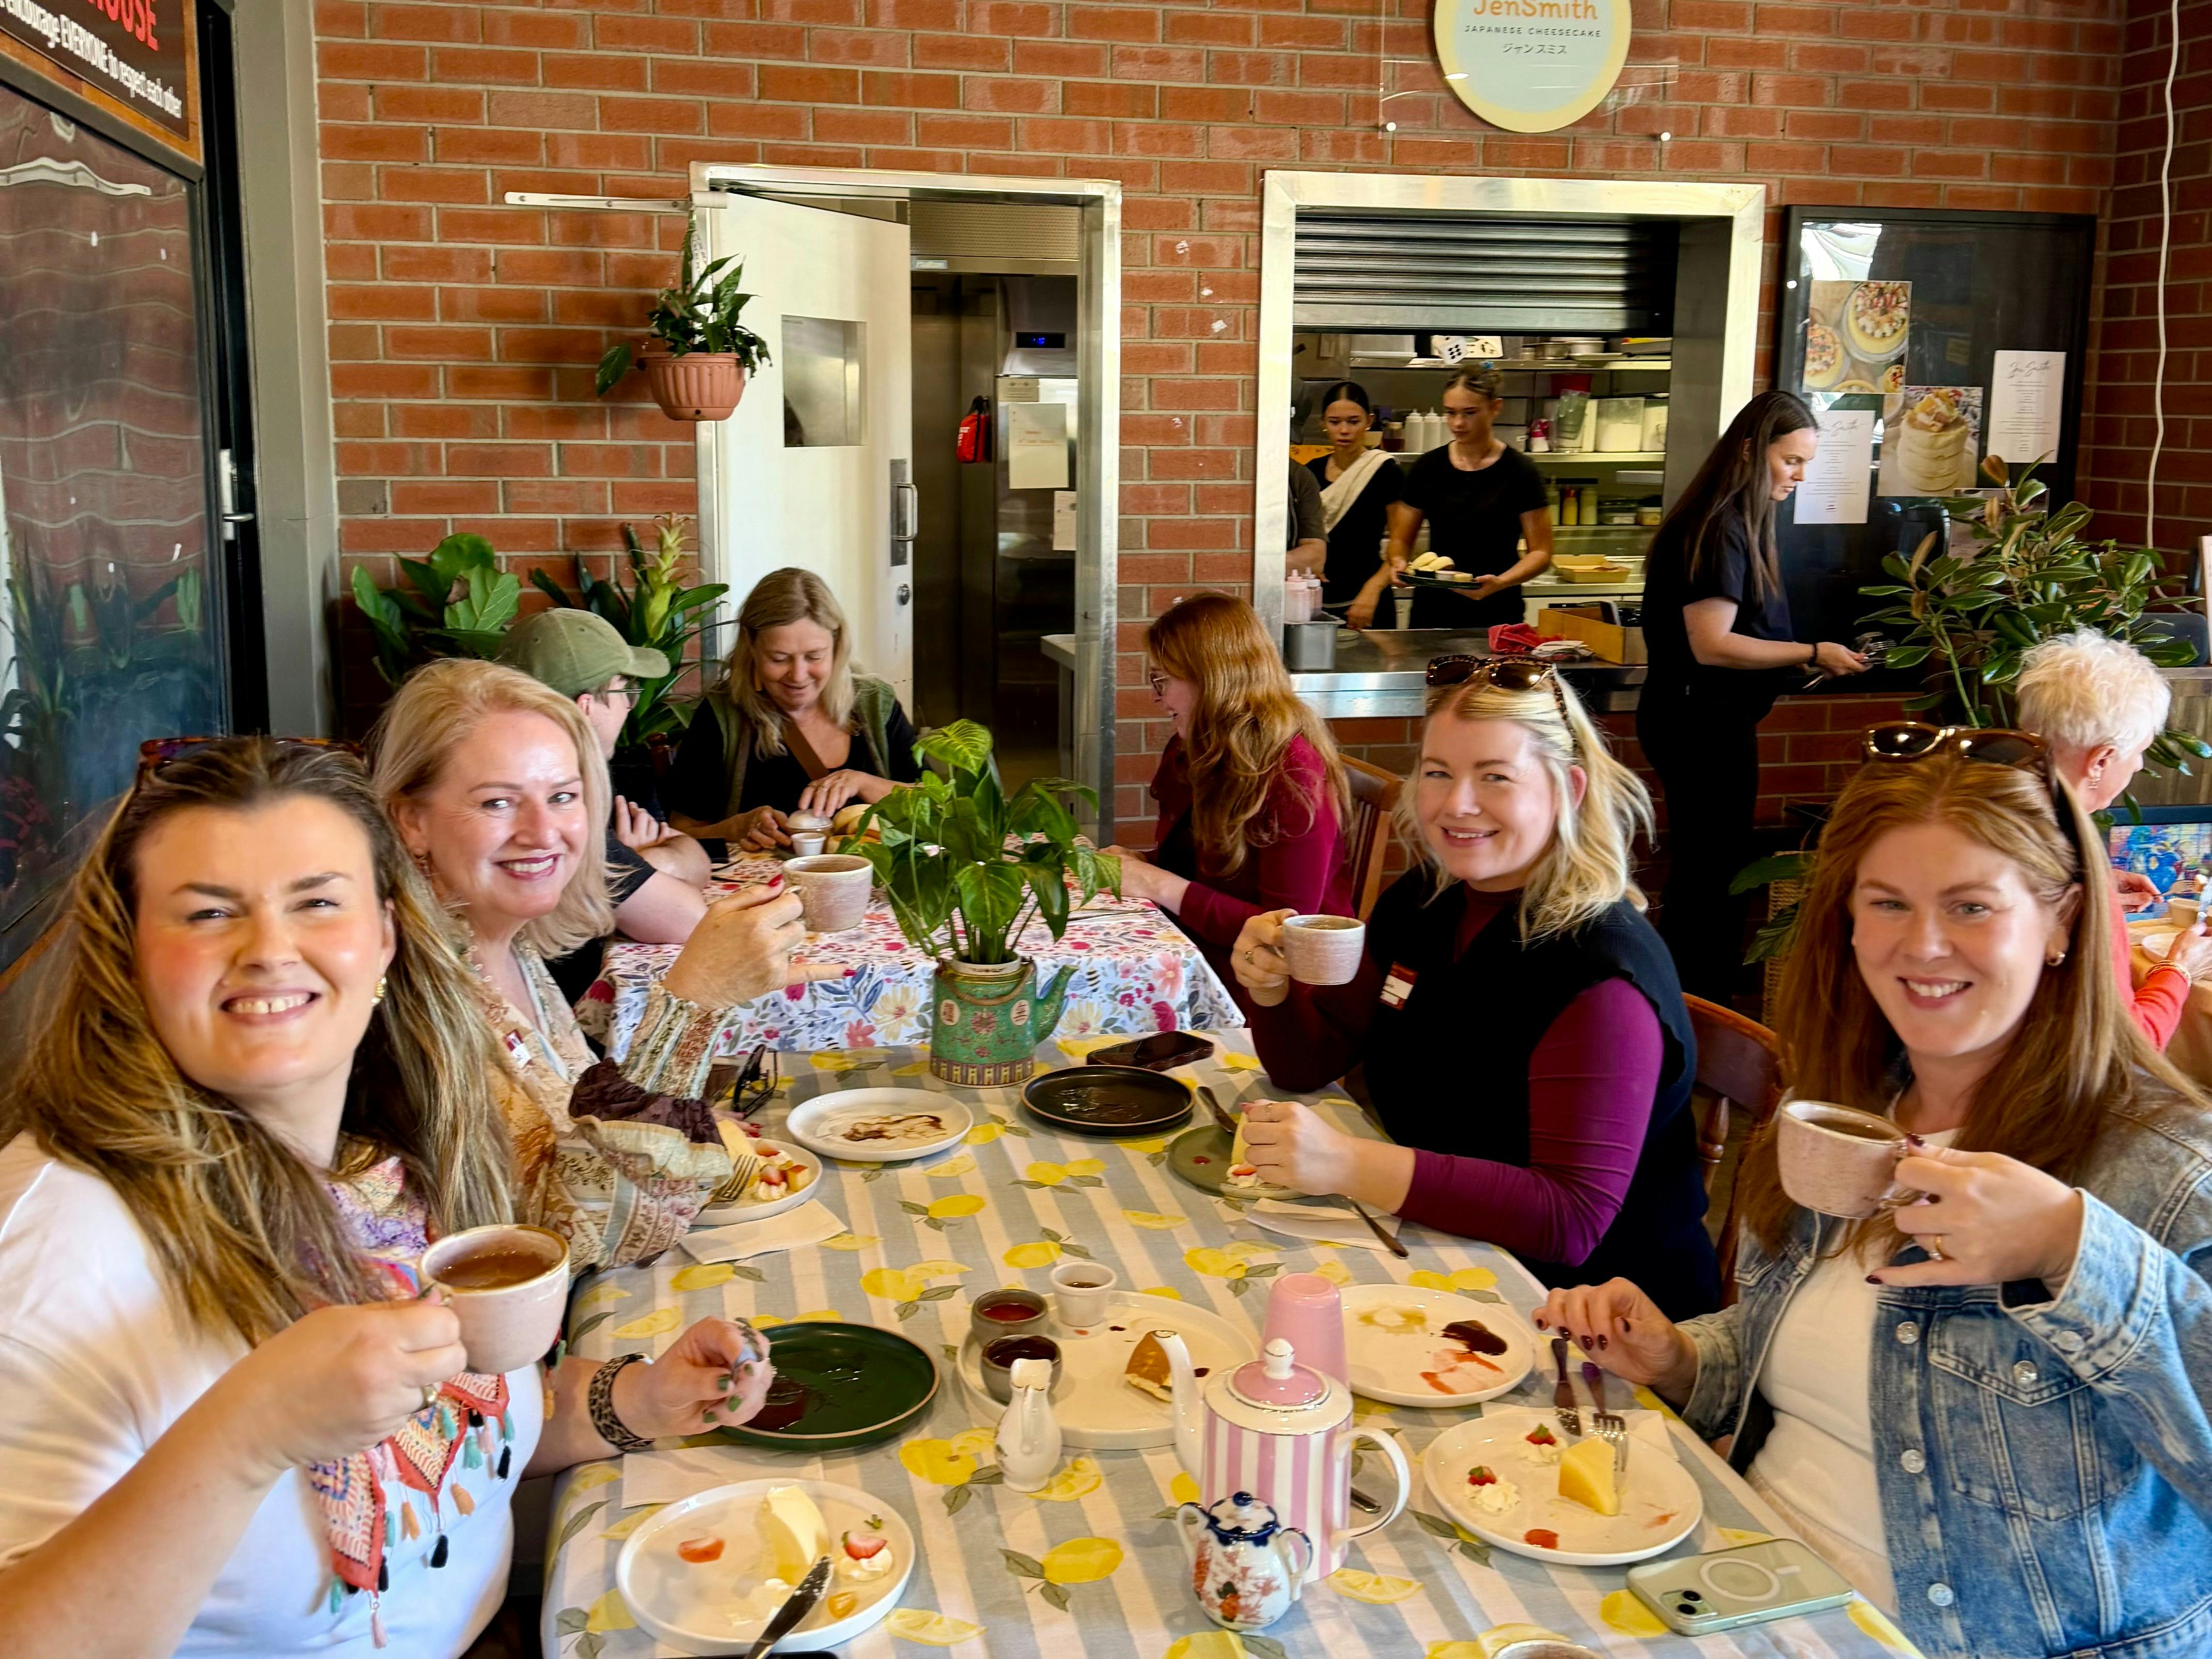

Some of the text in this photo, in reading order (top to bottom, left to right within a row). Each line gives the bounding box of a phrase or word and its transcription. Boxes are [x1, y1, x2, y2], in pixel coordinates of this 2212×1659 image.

[88, 0, 158, 51] USE
[1473, 0, 1598, 20] JenSmith
[60, 14, 108, 73] EVERYONE
[107, 49, 119, 80] to
[1464, 25, 1601, 37] JAPANESE CHEESECAKE
